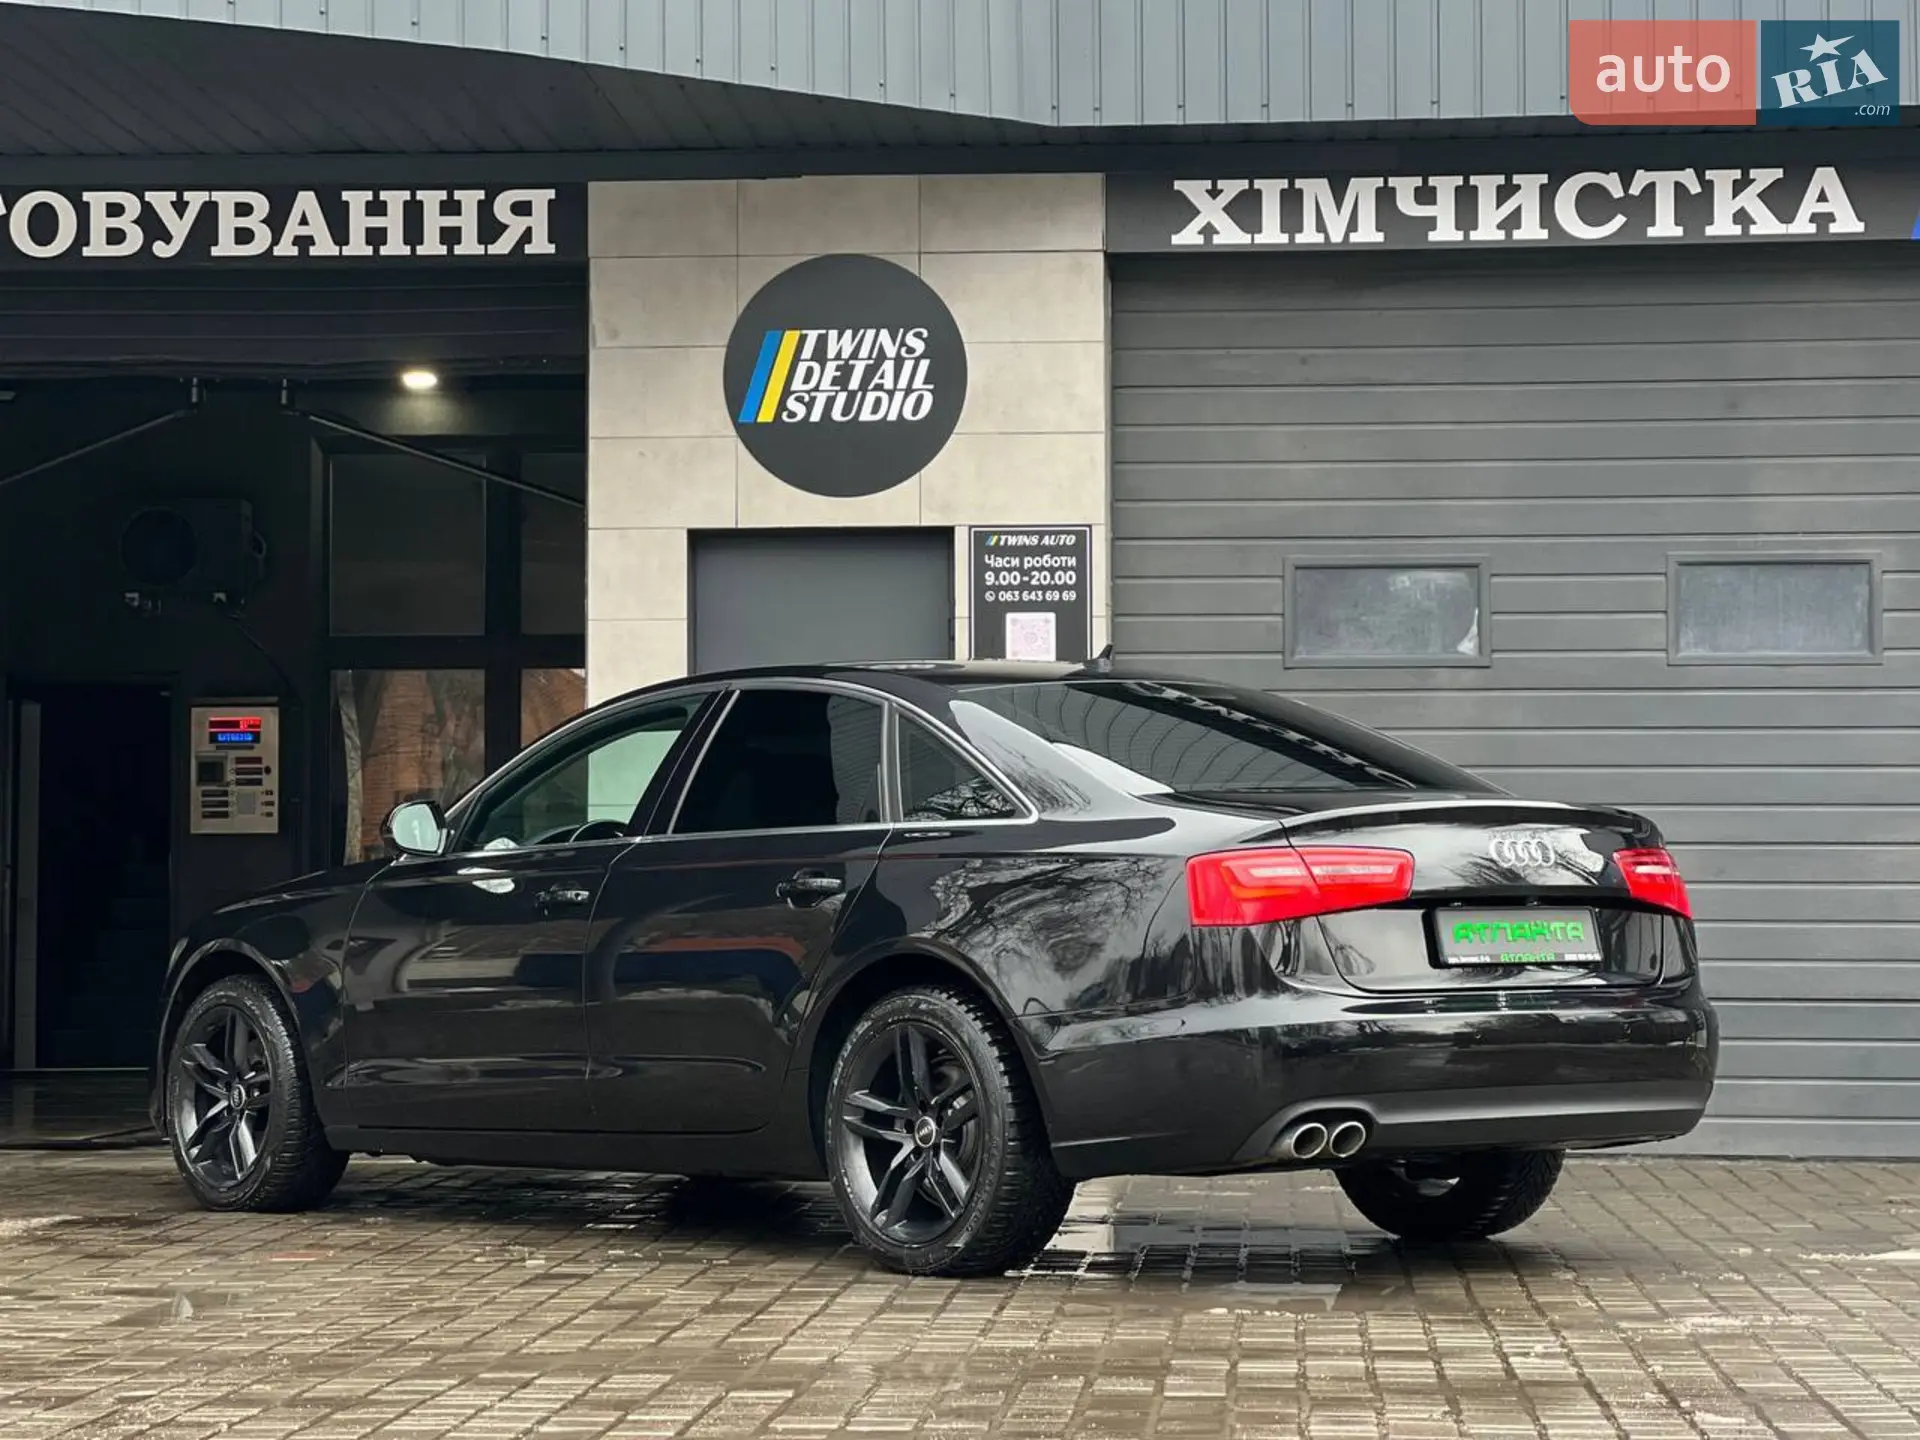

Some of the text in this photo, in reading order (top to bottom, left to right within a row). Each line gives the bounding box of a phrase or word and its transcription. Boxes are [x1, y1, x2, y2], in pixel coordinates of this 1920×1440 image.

[1171, 166, 1866, 245] ХІМЧИСТКА
[0, 188, 556, 258] ОВУВАННЯ
[800, 327, 928, 360] TWINS
[790, 359, 934, 391] DETAIL
[781, 390, 934, 422] STUDIO
[999, 534, 1076, 546] TWINS AUTO
[984, 554, 1076, 569] Часи роботи
[998, 590, 1020, 602] 063
[1045, 590, 1060, 602] 69
[1061, 590, 1077, 602] 69
